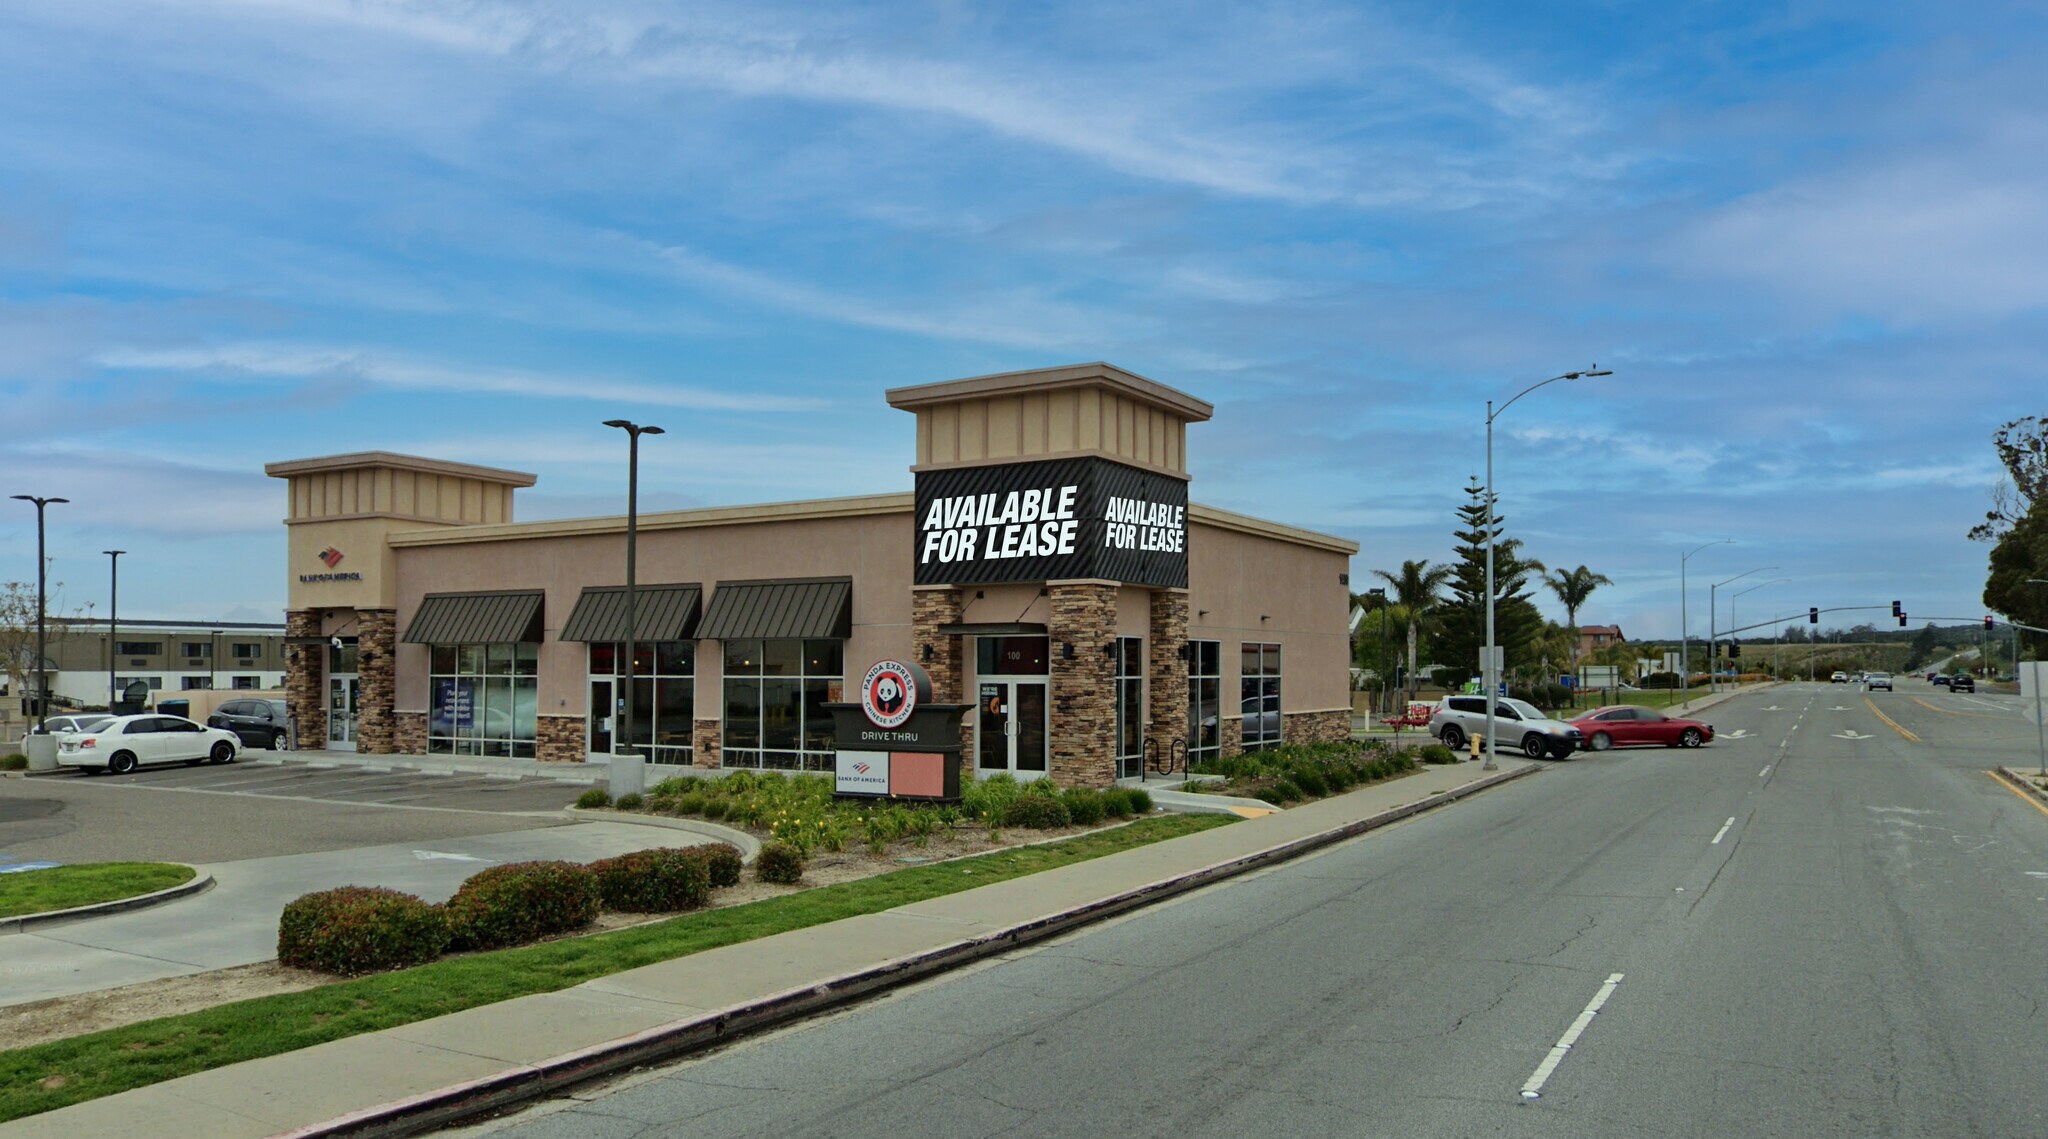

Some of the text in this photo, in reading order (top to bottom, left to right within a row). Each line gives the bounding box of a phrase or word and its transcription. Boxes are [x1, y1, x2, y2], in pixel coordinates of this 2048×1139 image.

[922, 485, 1078, 531] AVAILABLE
[1104, 496, 1184, 529] AVAILABLE
[921, 519, 1079, 564] FOR LEASE
[1105, 522, 1184, 553] FOR LEASE
[1007, 651, 1020, 660] 100
[863, 662, 914, 691] PANDA EXPRESS
[865, 702, 912, 725] CHINESE KITCHEN
[861, 731, 918, 742] DRIVE THRU
